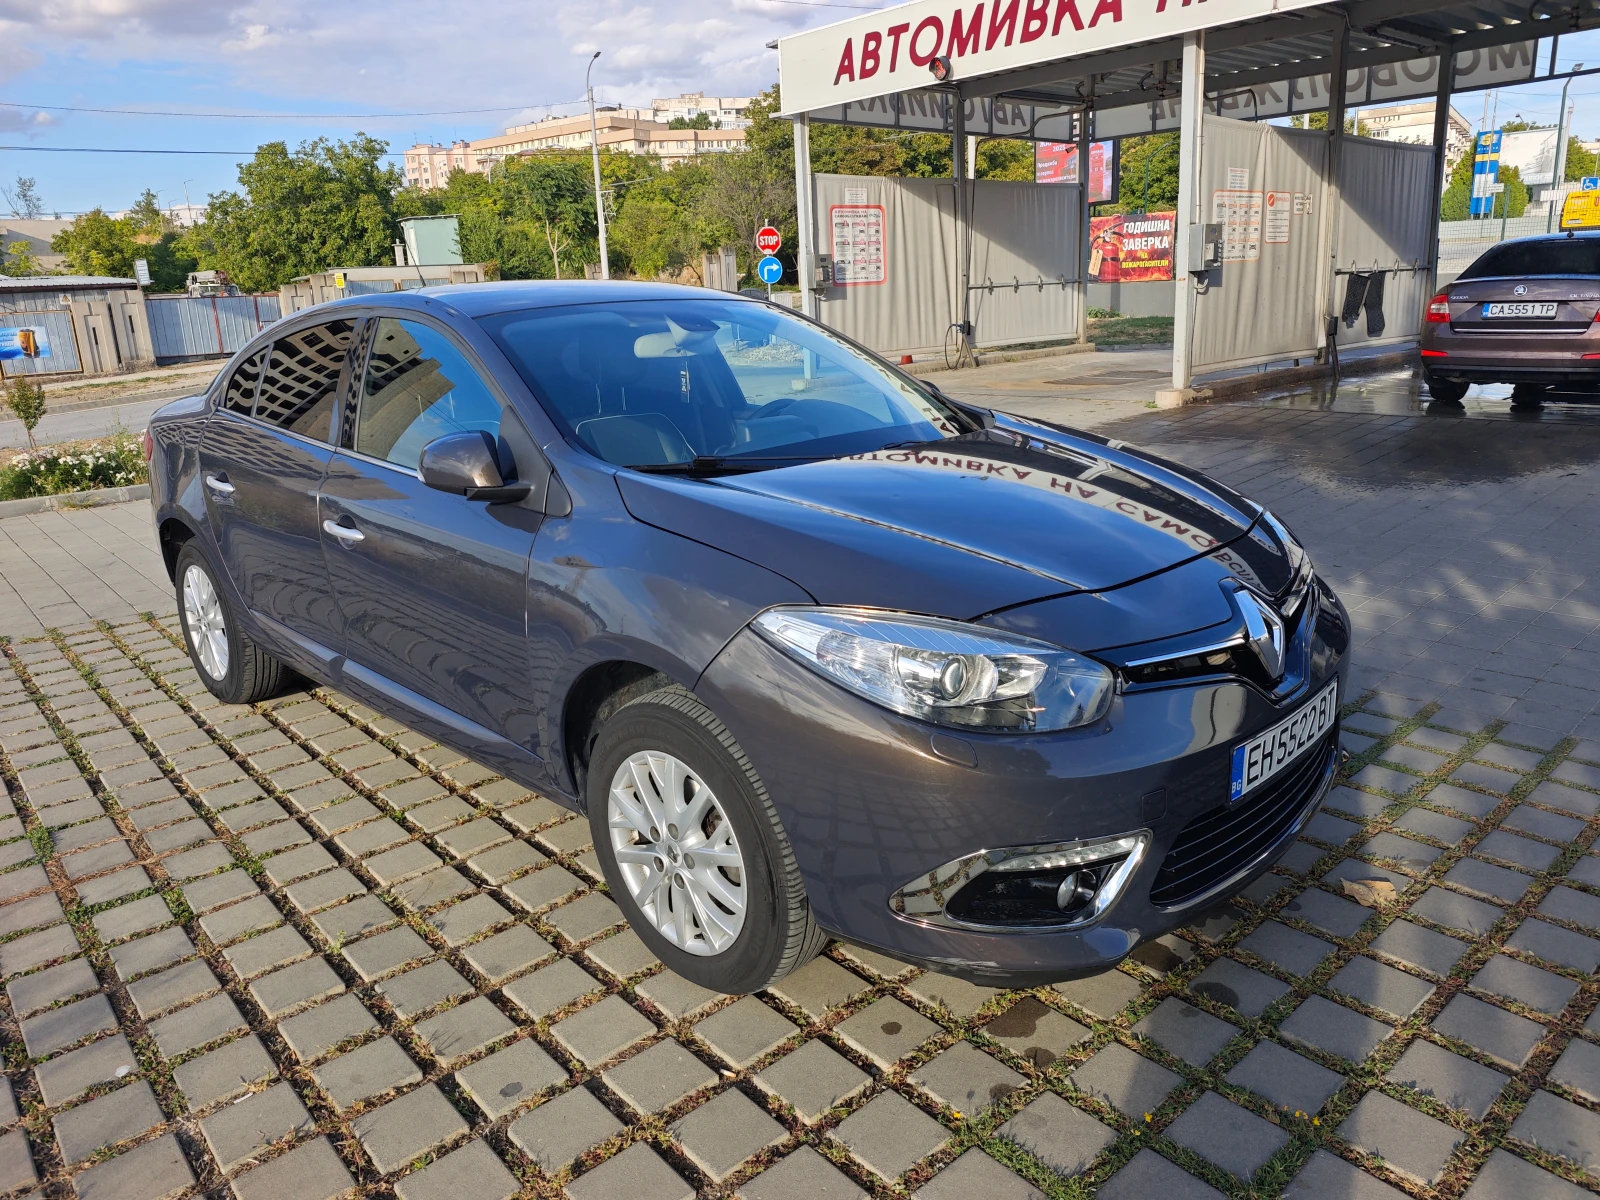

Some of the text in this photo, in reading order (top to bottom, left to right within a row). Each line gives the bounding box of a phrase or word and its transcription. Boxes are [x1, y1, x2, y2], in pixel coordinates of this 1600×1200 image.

[1123, 219, 1170, 234] ГОДИШНА
[759, 235, 778, 246] STOP
[1122, 236, 1169, 251] ЗАВЕРКА
[1121, 260, 1169, 269] ПОЖАРОГАСИТЕЛИ
[1231, 778, 1242, 794] BG
